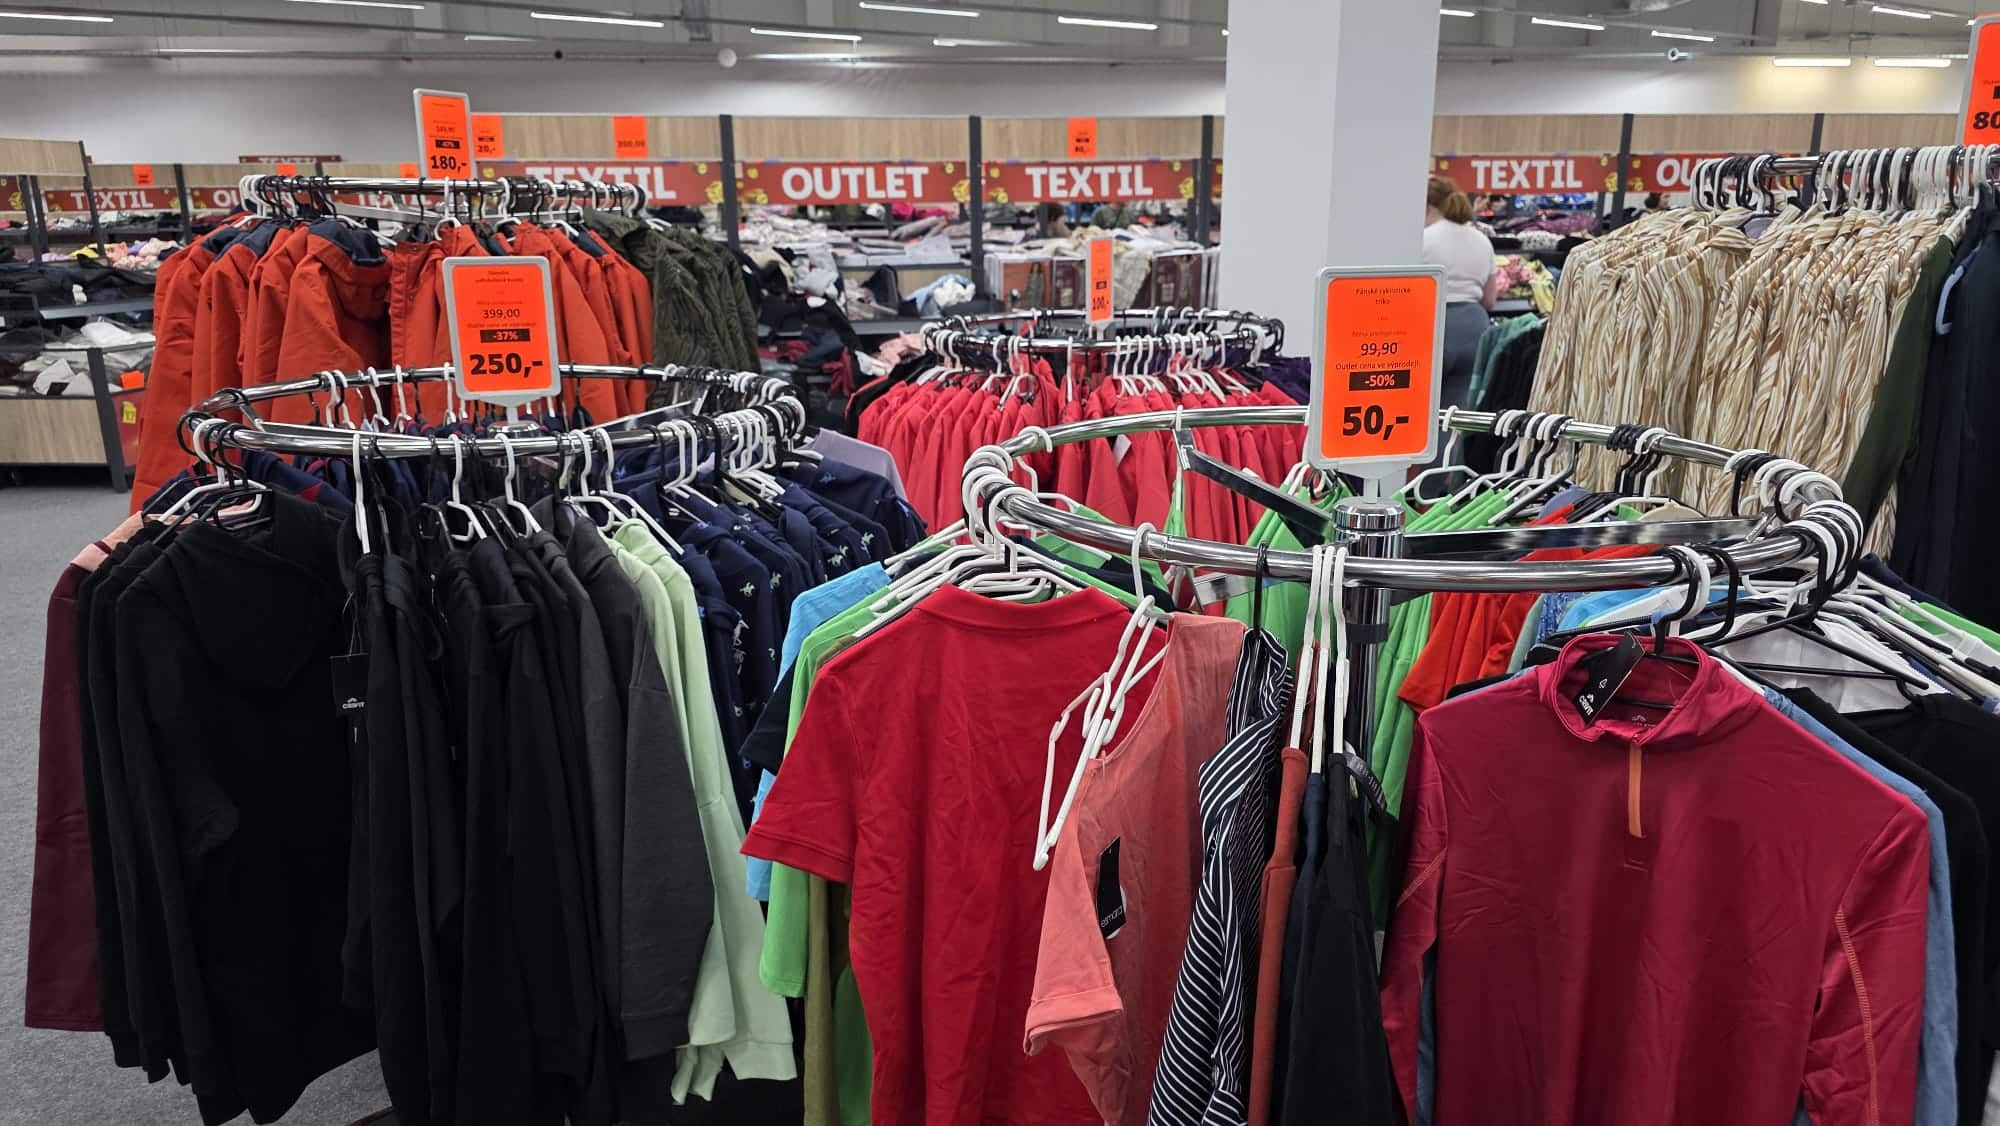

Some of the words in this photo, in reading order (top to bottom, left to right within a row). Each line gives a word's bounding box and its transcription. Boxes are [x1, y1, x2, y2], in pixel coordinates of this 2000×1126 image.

[431, 155, 467, 173] 180,-
[1471, 160, 1583, 189] TEXTIL
[782, 167, 929, 200] OUTLET
[1025, 165, 1154, 199] TEXTIL
[483, 309, 520, 319] 399,00
[493, 331, 518, 341] -37%
[1361, 342, 1398, 357] 99,90
[469, 352, 543, 378] 250,-
[1365, 374, 1395, 386] -50%
[1343, 405, 1409, 440] 50,-
